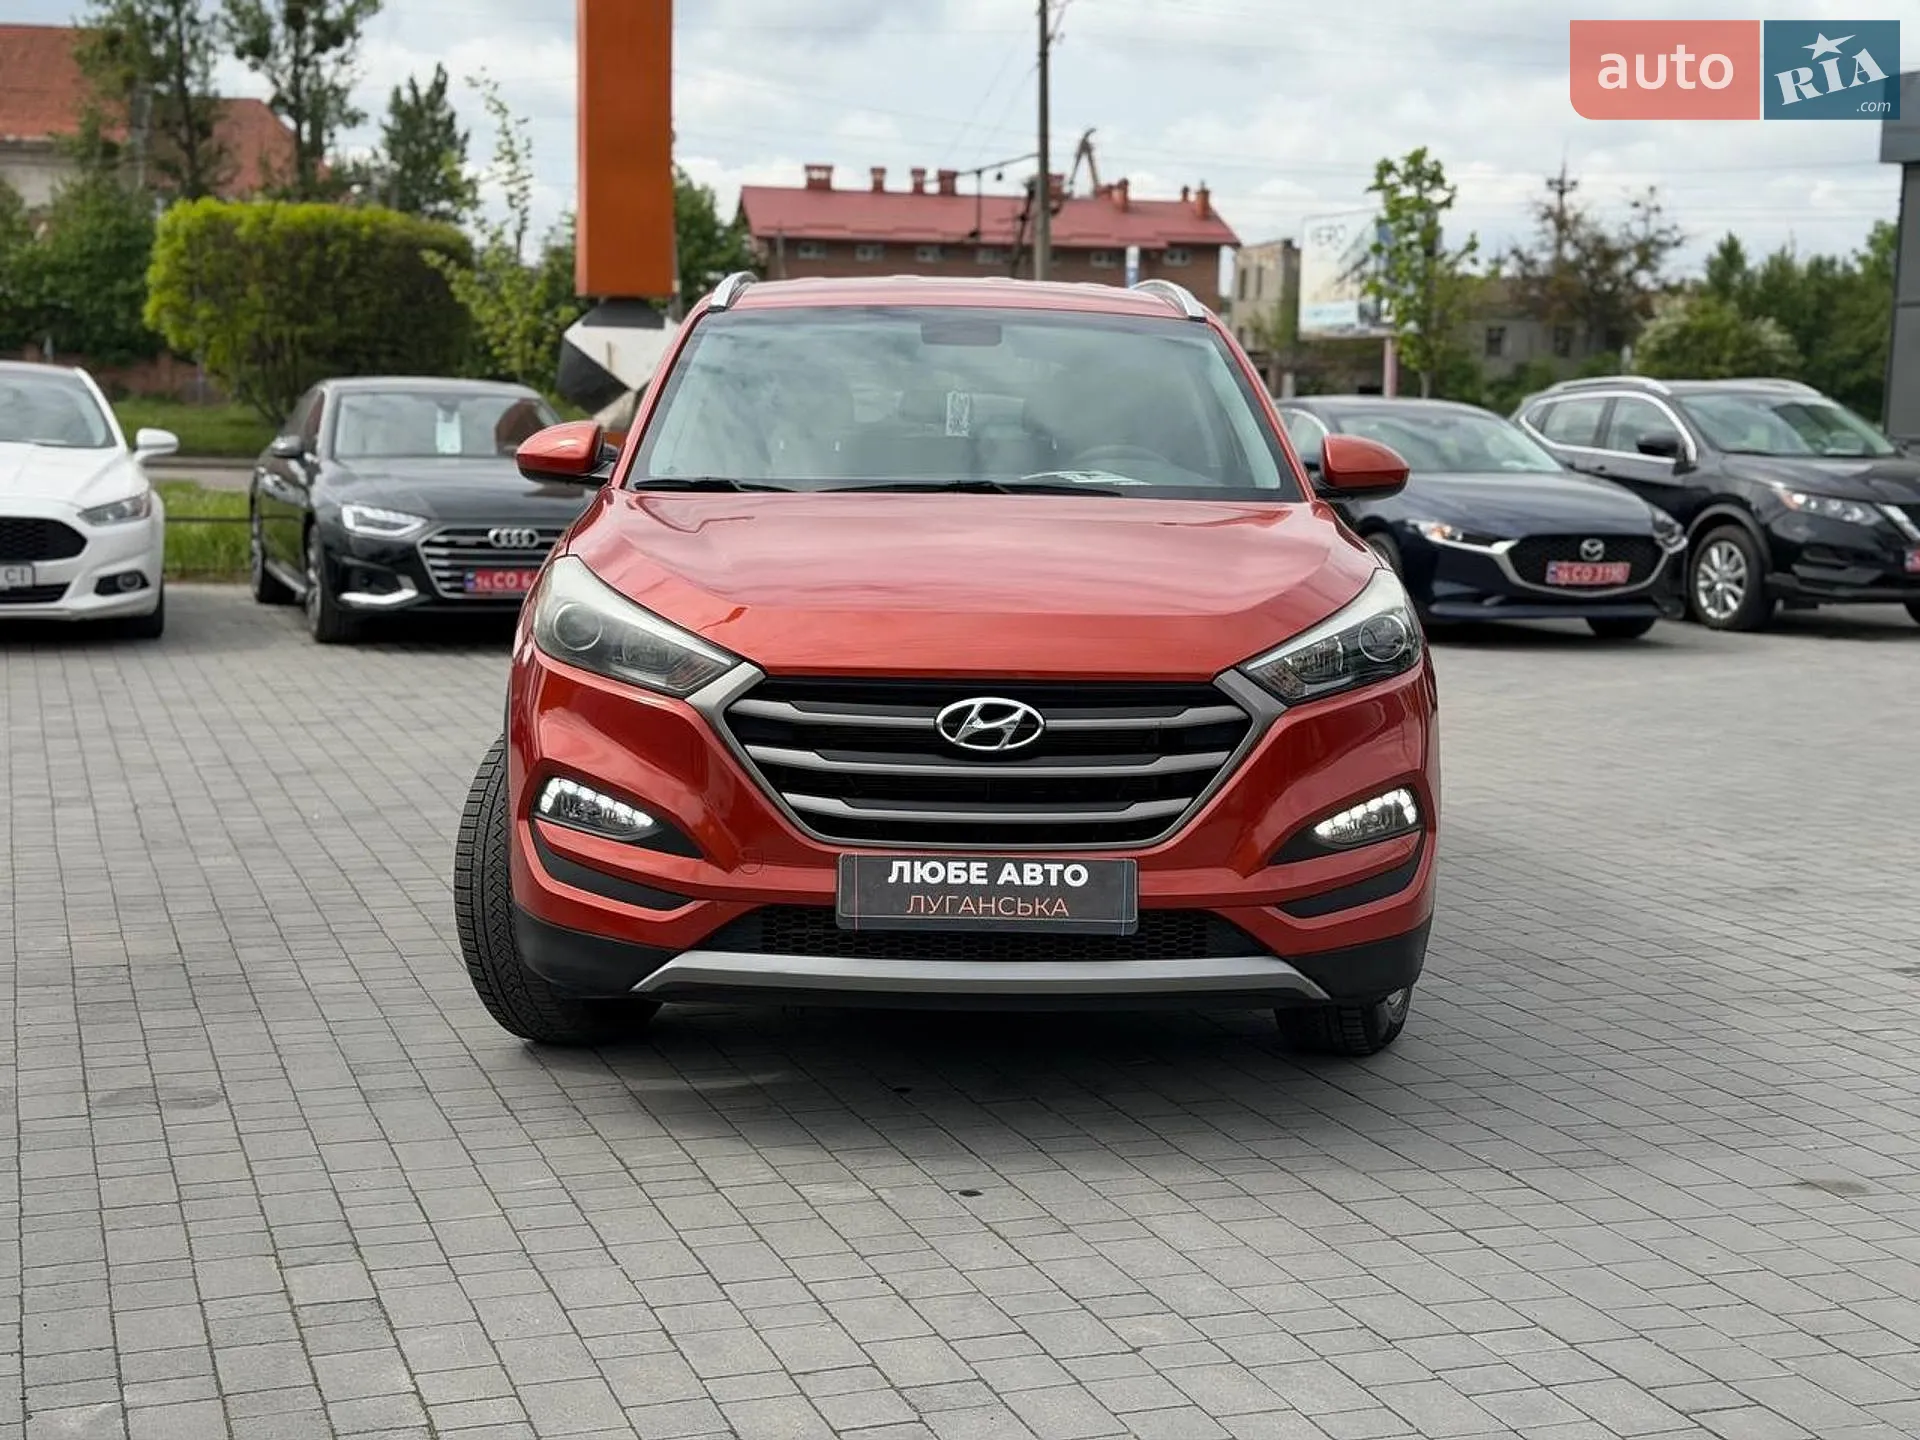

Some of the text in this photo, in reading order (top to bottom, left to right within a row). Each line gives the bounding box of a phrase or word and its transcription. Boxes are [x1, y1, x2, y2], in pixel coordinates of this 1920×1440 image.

[887, 860, 1090, 887] ЛЮБЕ АВТО
[906, 894, 1071, 918] ЛУГАНСЬКА
